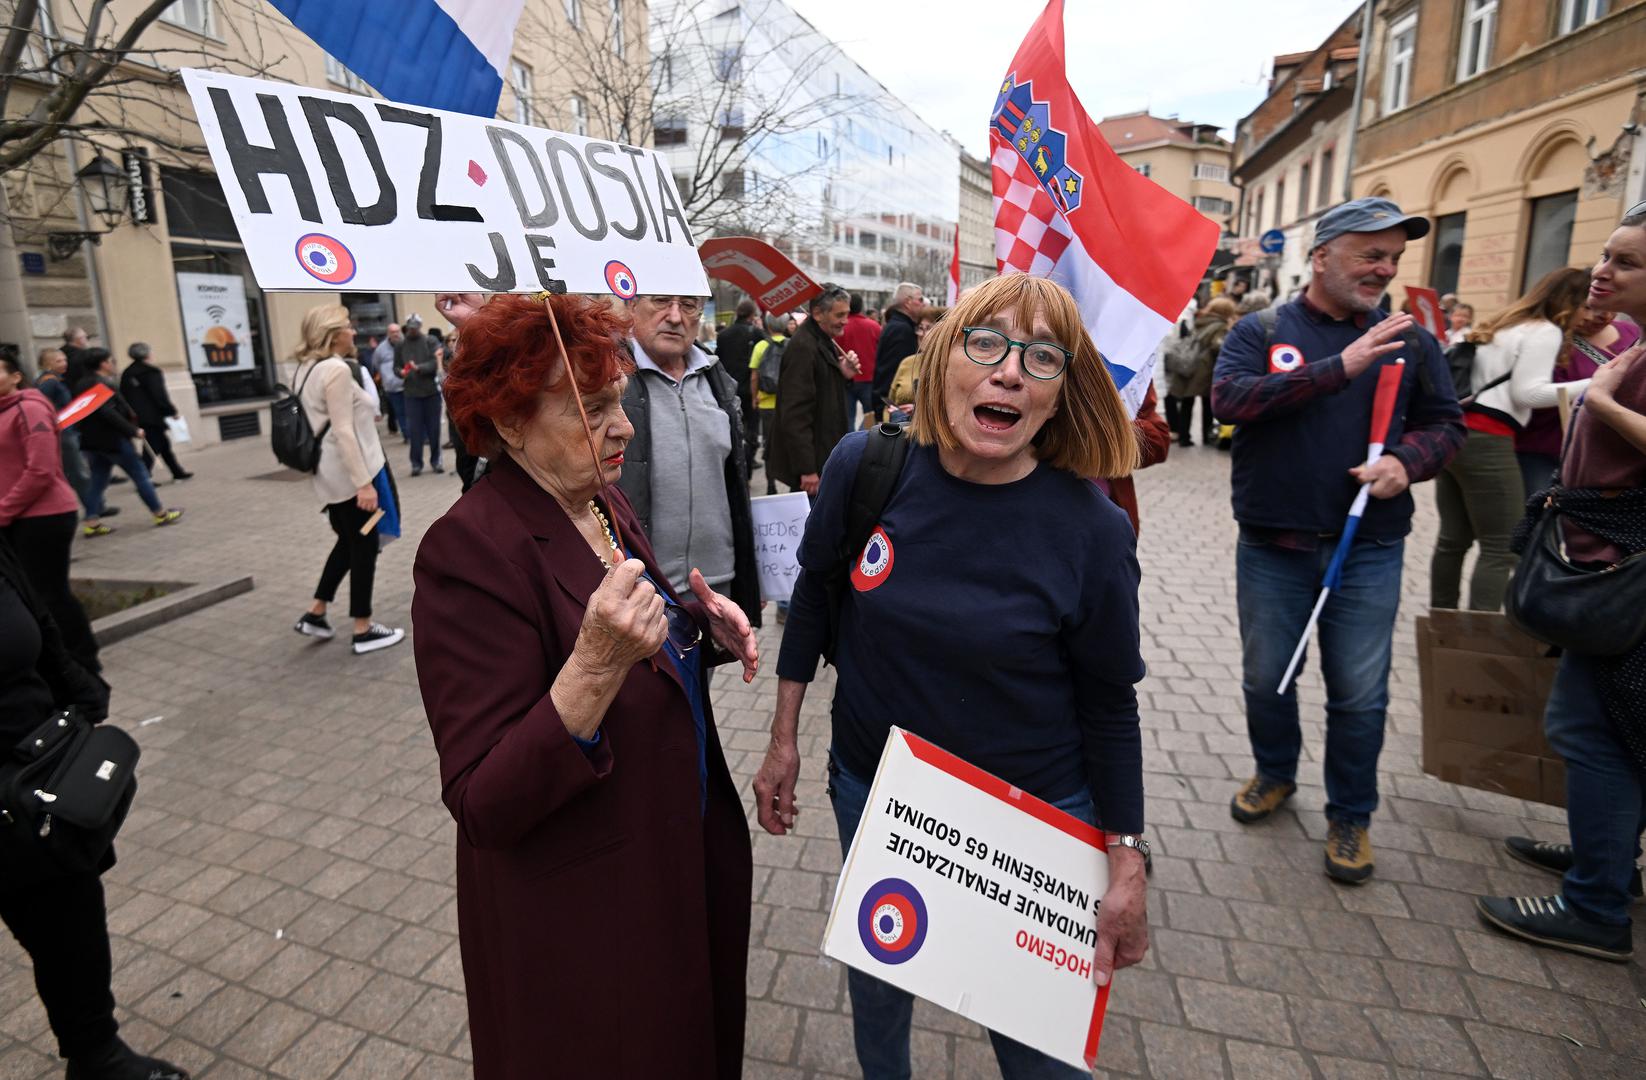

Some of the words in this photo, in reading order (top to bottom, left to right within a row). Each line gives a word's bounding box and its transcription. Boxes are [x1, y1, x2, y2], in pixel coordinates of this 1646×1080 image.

[207, 87, 485, 226] HDZ
[486, 125, 694, 246] DOSTA
[465, 232, 566, 294] JE
[762, 287, 793, 306] Dosta
[787, 276, 807, 292] je!
[885, 797, 961, 847] GODINA!
[964, 836, 989, 860] 65
[886, 832, 1012, 907] PENALIZACIJE
[992, 849, 1089, 911] NAVRŠENIH
[1014, 893, 1098, 948] UKIDANJE
[1016, 929, 1092, 979] HOĆEMO
